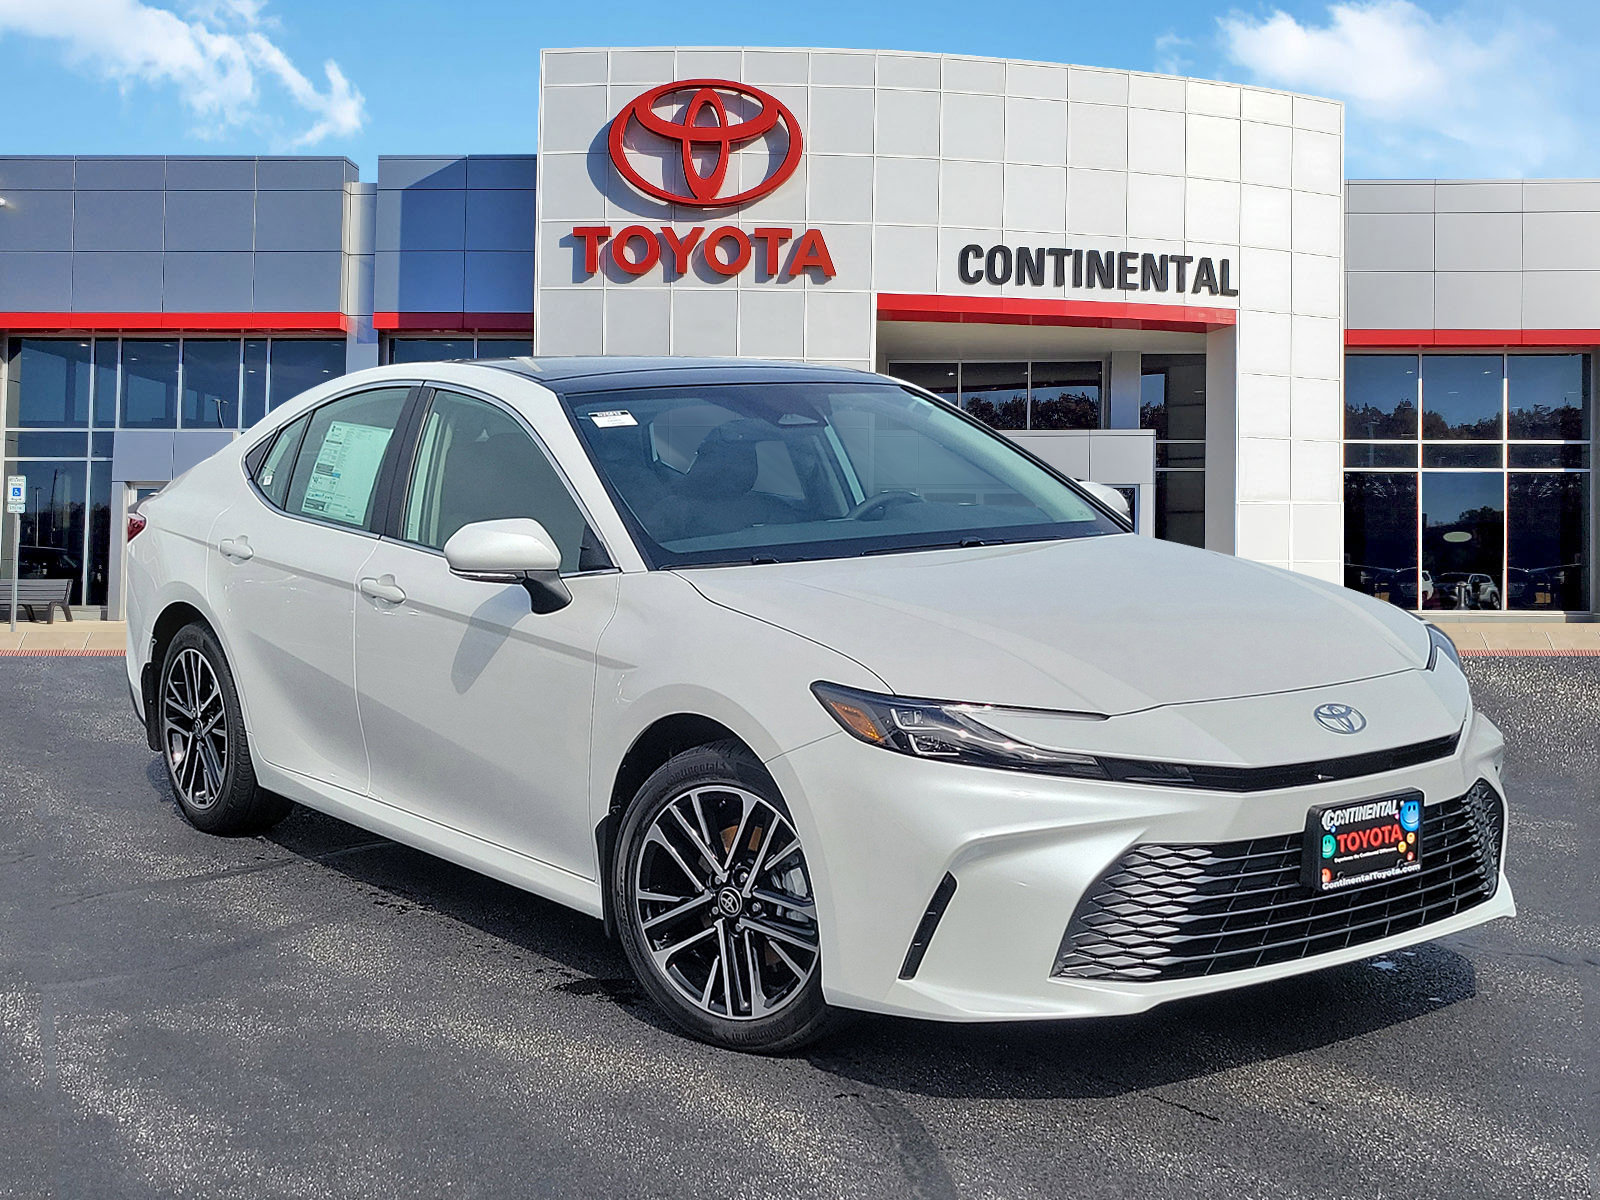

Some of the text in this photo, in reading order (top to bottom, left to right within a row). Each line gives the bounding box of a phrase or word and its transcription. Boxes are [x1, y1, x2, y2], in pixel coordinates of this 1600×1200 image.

[573, 225, 836, 277] TOYOTA
[958, 244, 1239, 297] CONTINENTAL
[1322, 800, 1399, 831] CONTINENTAL
[1337, 824, 1403, 853] TOYOTA
[1322, 864, 1420, 890] ContinentalToyota.com
